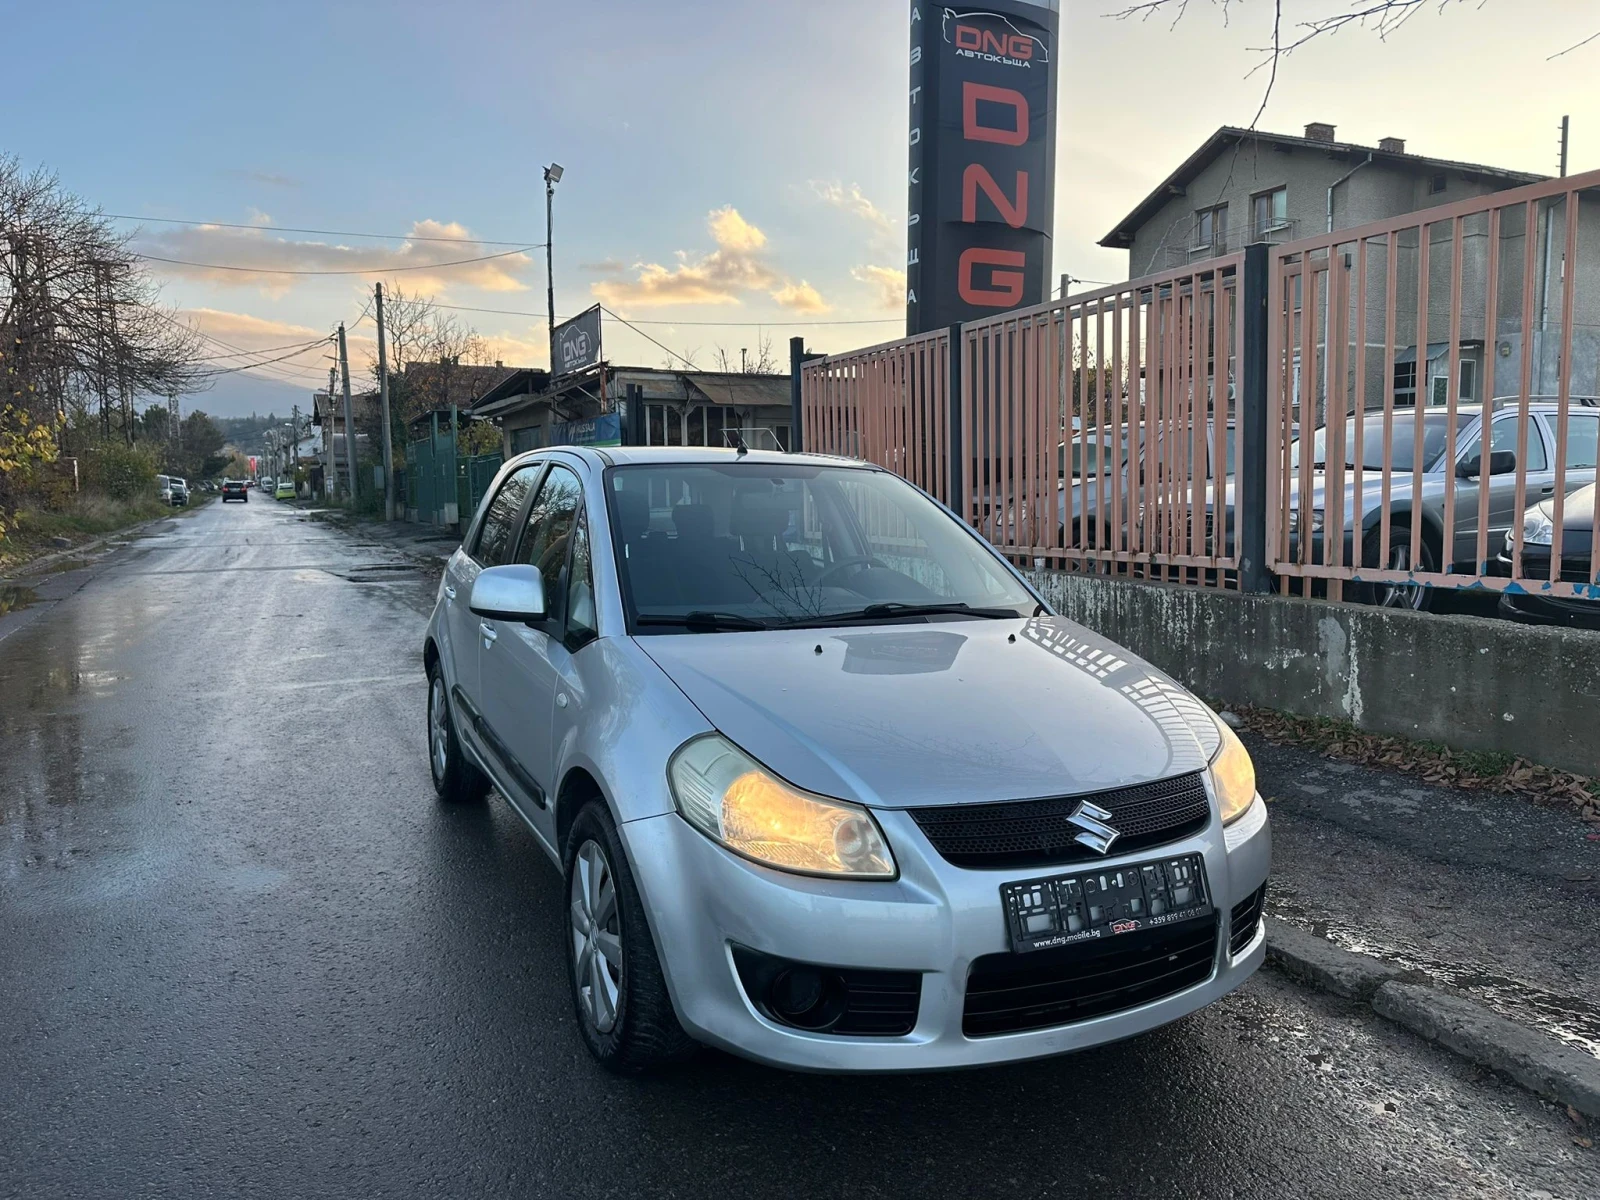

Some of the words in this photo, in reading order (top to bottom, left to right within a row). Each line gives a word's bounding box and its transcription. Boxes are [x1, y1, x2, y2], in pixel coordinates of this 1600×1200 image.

[956, 25, 1033, 60] DNG
[955, 49, 1031, 68] АВТОКЪЩА
[957, 81, 1029, 308] DNG
[563, 334, 587, 362] DNG
[1113, 921, 1136, 932] DNG
[1149, 915, 1166, 925] +359
[1033, 928, 1101, 948] www.dng.mobile.bg
